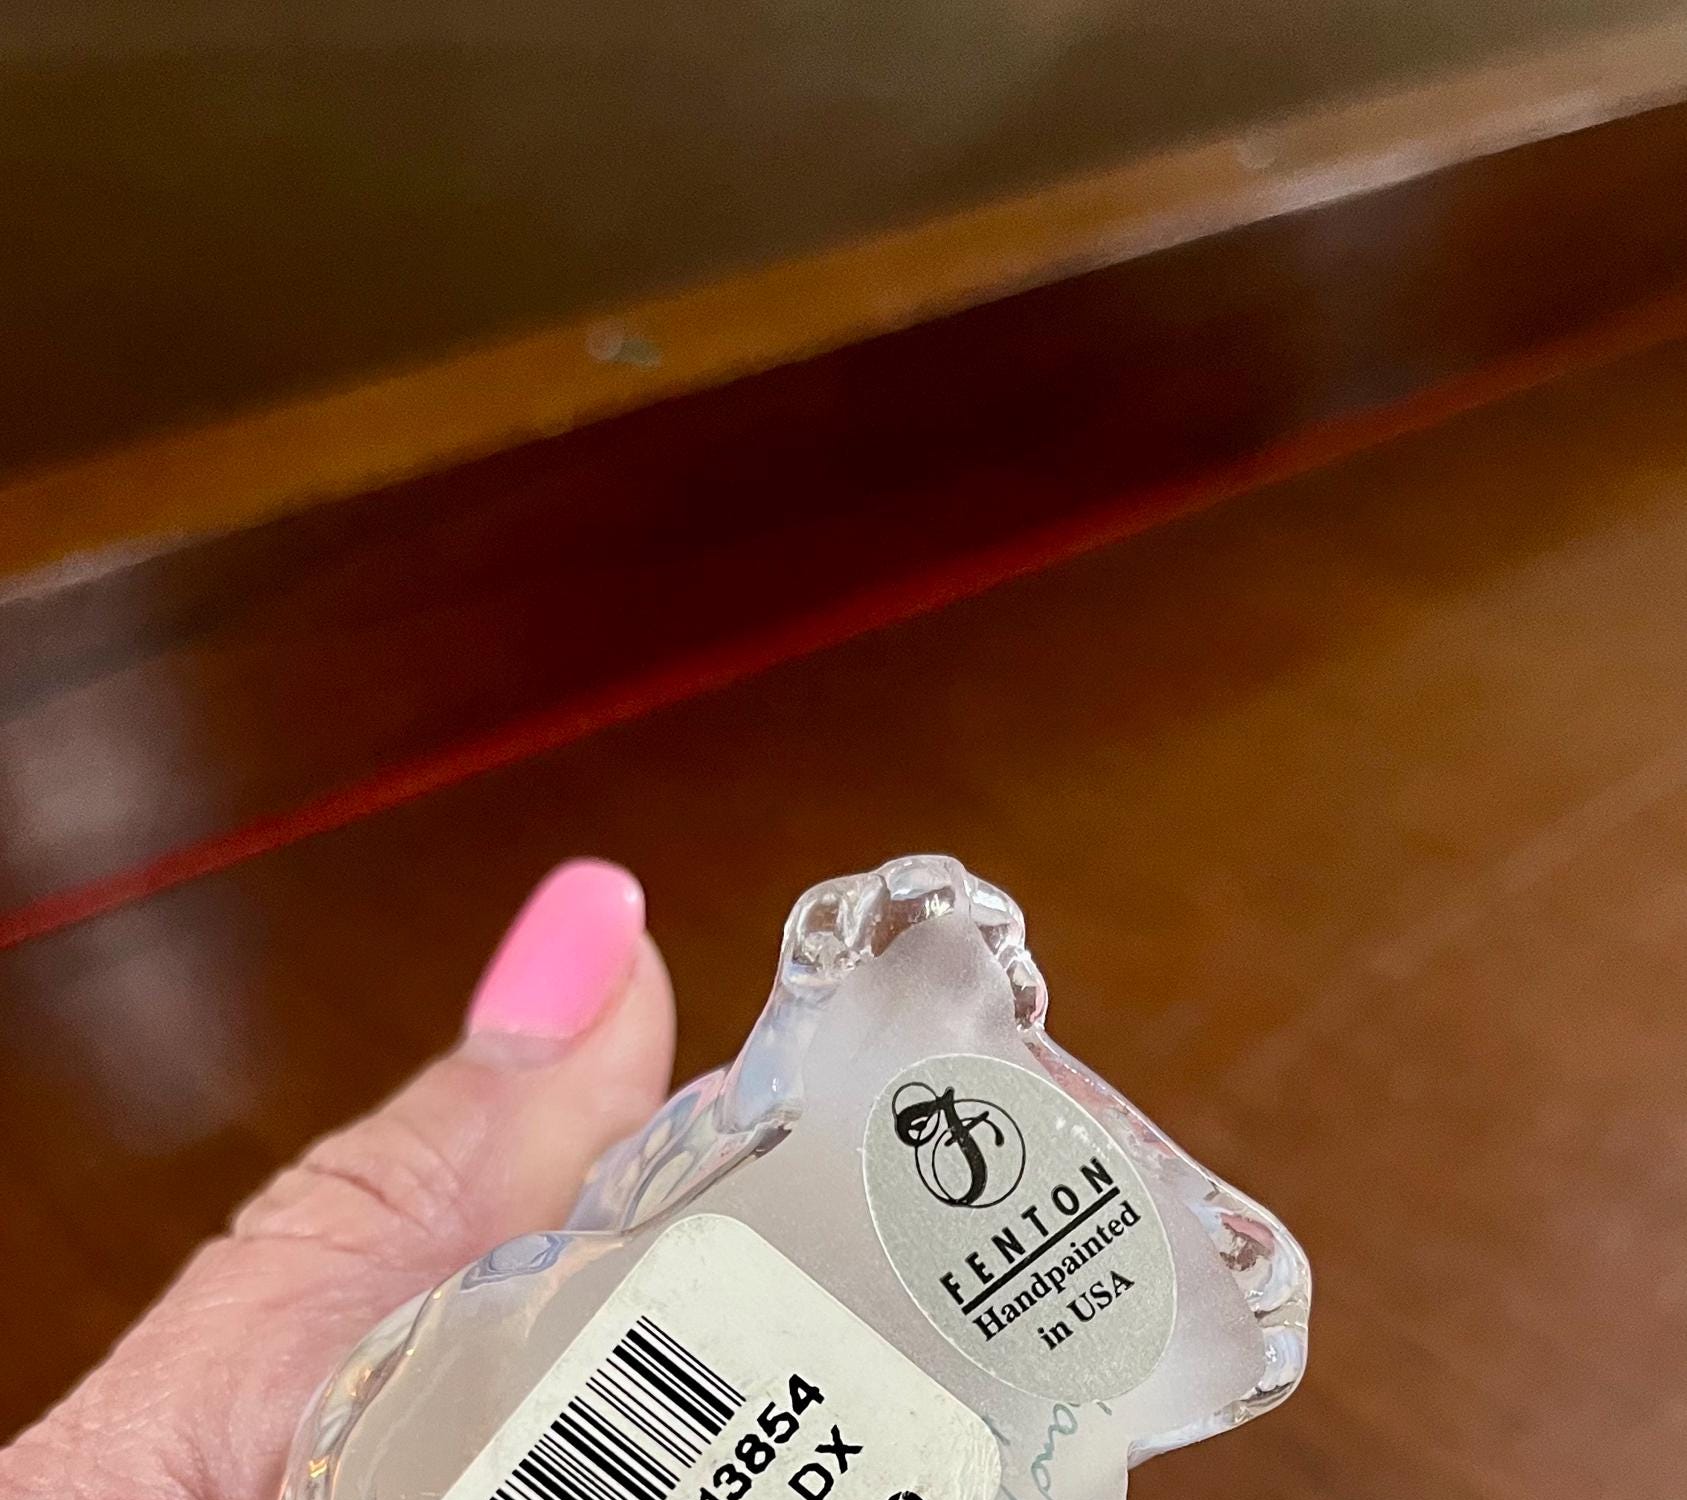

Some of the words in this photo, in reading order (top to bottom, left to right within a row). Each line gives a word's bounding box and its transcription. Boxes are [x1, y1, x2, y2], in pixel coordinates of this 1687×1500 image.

[939, 1156, 1115, 1306] FENTON
[972, 1200, 1142, 1342] Handpainted
[1036, 1321, 1074, 1351] in
[1066, 1270, 1136, 1323] USA
